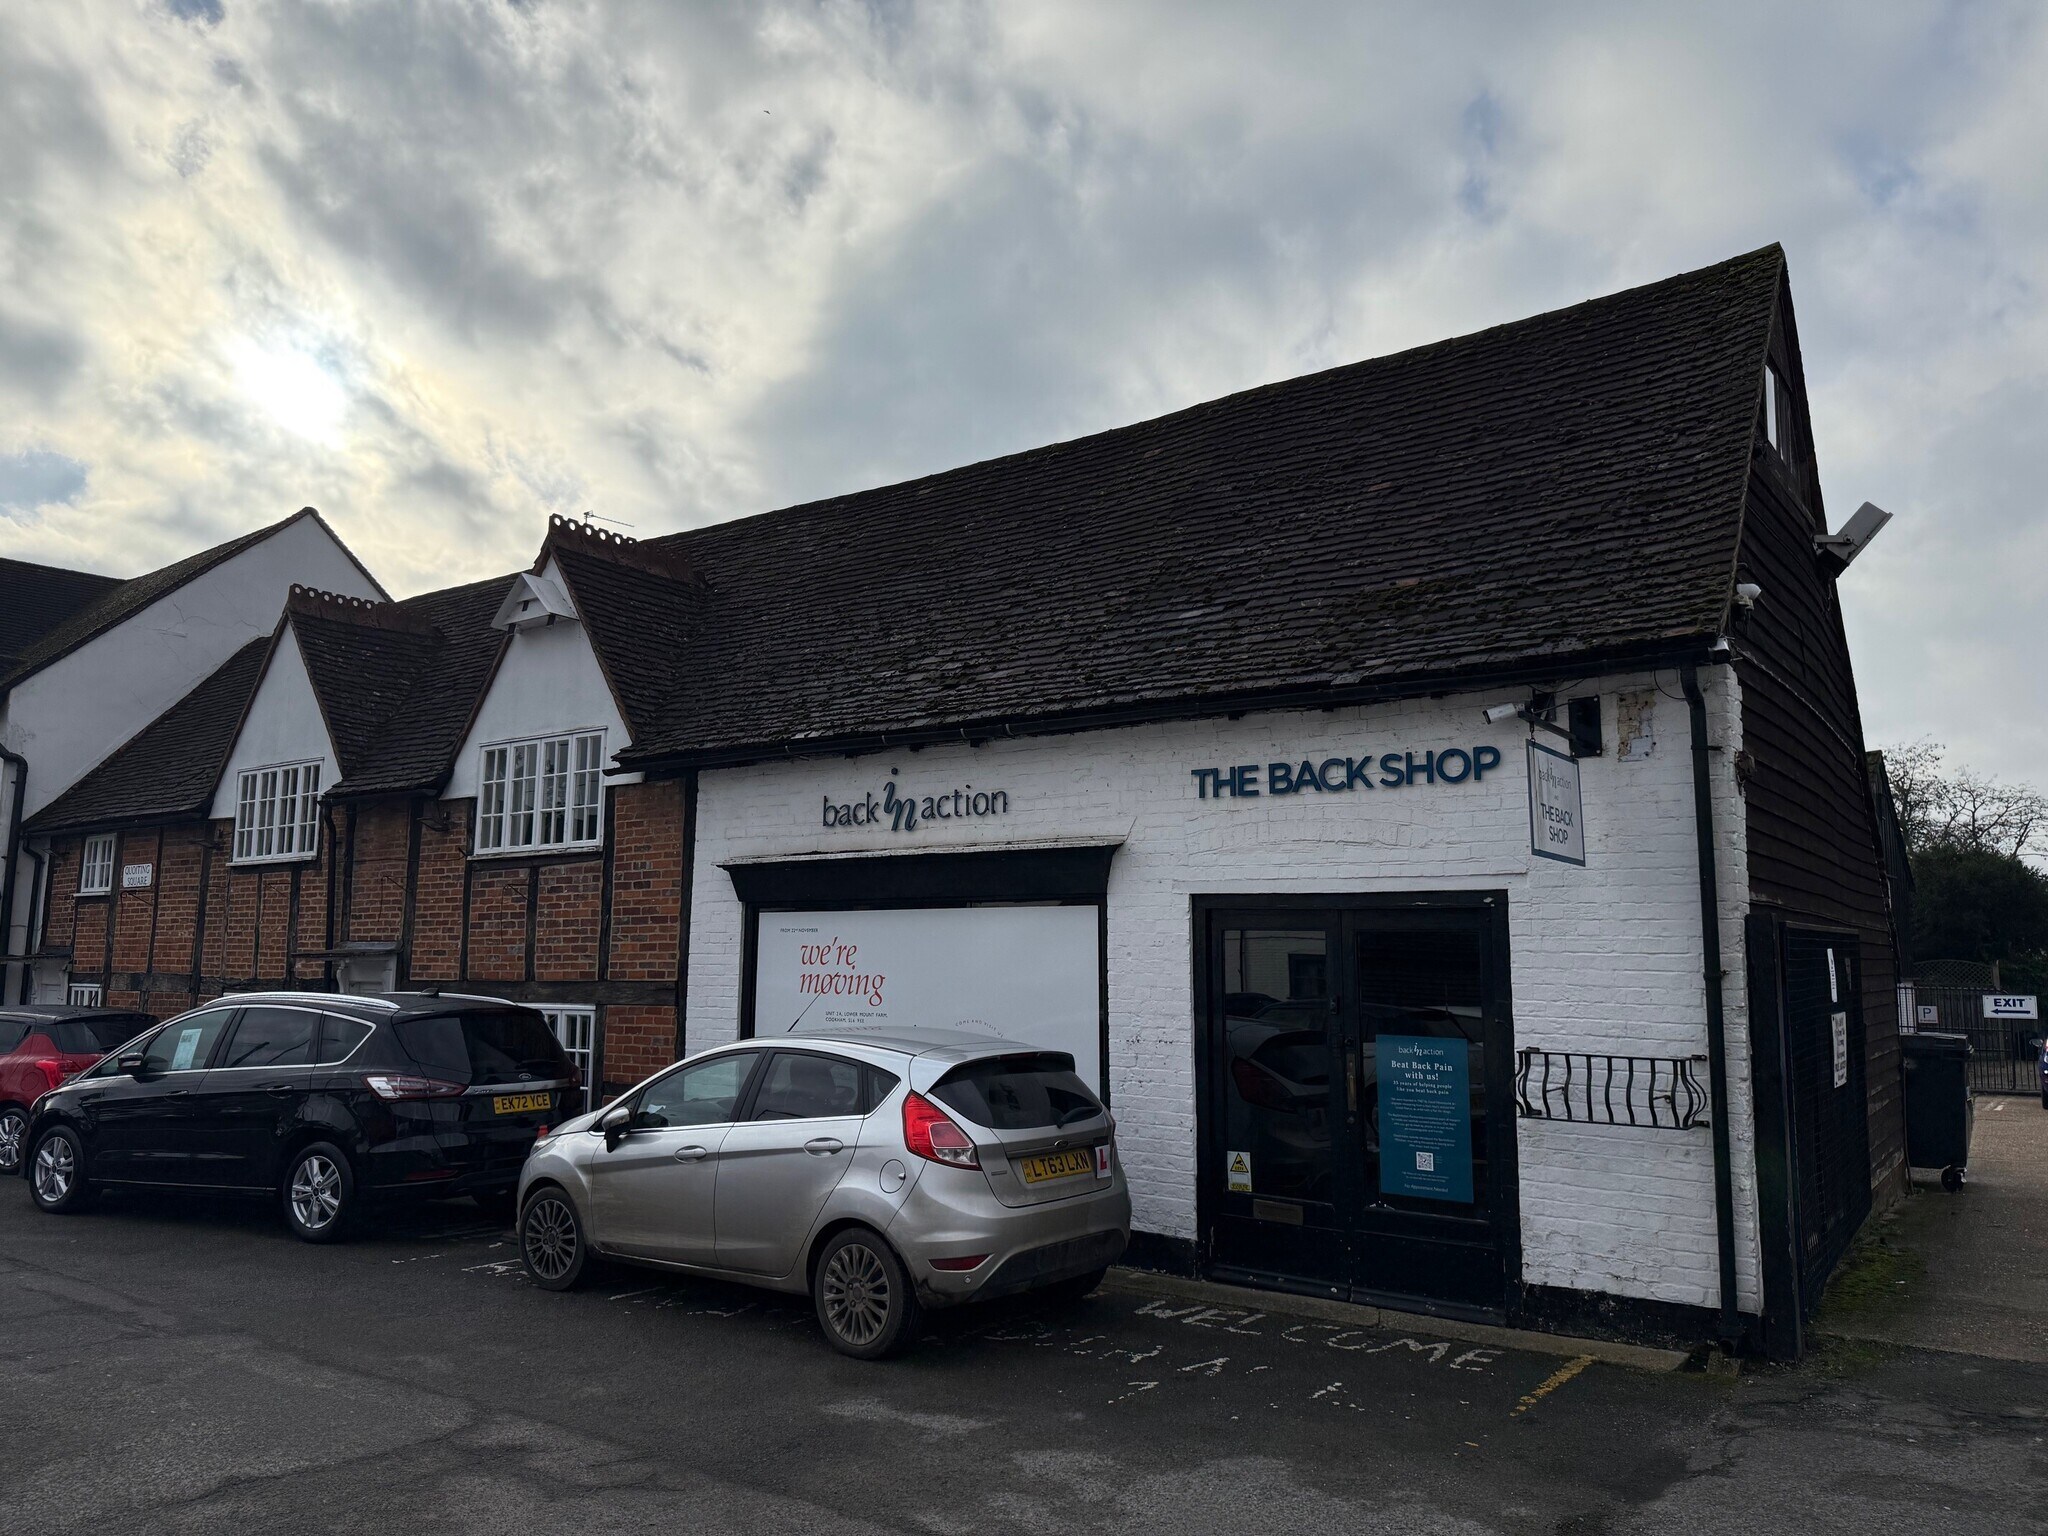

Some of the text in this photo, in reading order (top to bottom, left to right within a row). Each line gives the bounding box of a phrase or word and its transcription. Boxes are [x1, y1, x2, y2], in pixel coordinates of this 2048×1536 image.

[1190, 745, 1501, 799] THE BACK SHOP
[822, 767, 1009, 831] back in action
[1540, 803, 1574, 828] THE BACK
[1549, 825, 1569, 845] SHOP
[125, 864, 150, 875] QUOITING
[127, 876, 147, 886] SQUARE
[800, 936, 858, 966] we're
[800, 965, 886, 1007] moving
[1993, 998, 2026, 1008] EXIT
[1922, 1007, 1932, 1019] P
[1398, 1045, 1413, 1054] back
[1423, 1047, 1444, 1056] action
[1391, 1060, 1453, 1071] Beat Back Pain
[1404, 1071, 1439, 1081] with us!
[501, 1094, 549, 1110] EK72 YCE
[1030, 1156, 1065, 1178] LT63
[1065, 1151, 1090, 1171] LXN
[1099, 1148, 1108, 1170] L
